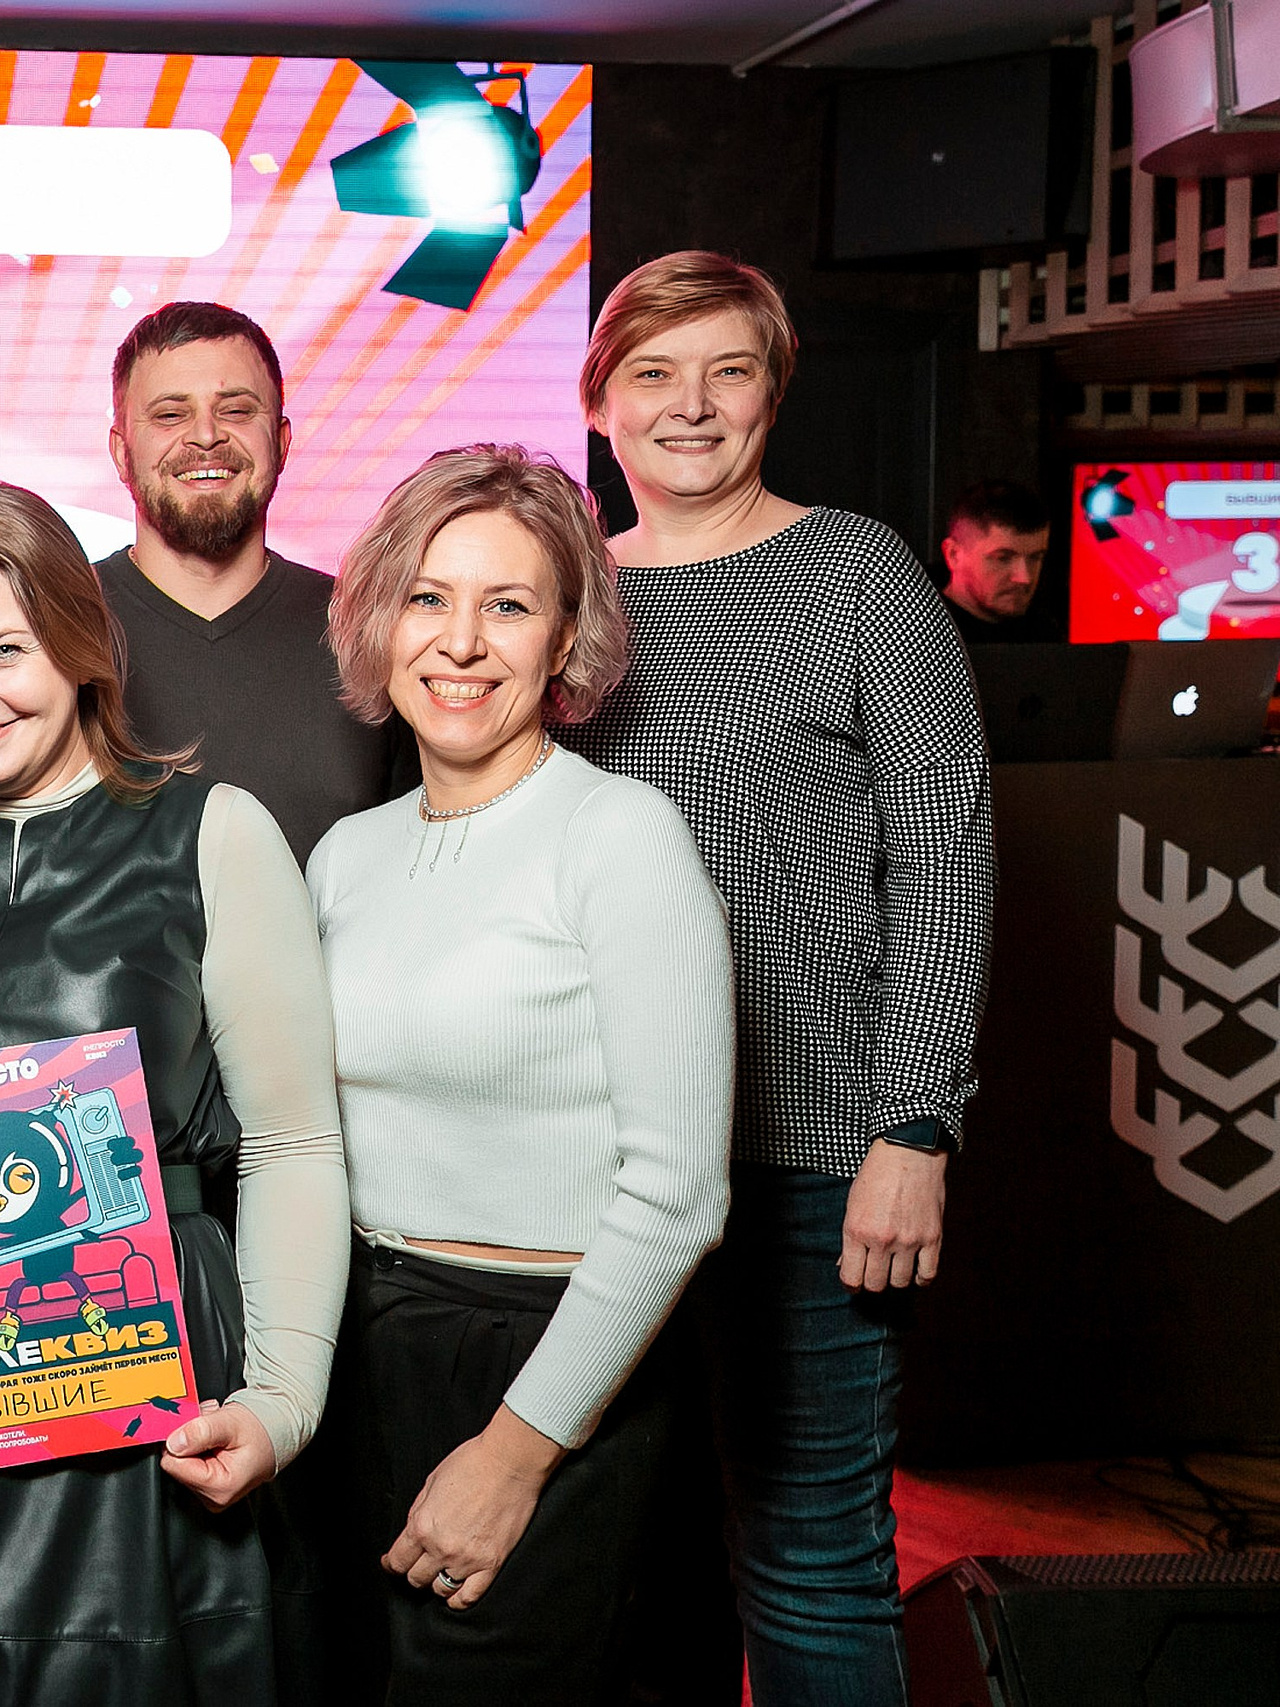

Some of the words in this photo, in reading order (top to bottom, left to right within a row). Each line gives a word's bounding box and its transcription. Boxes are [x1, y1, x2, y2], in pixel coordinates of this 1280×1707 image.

[1232, 531, 1279, 593] 3
[22, 1373, 47, 1385] ТОЖЕ
[48, 1368, 78, 1380] СКОРО
[114, 1357, 148, 1369] ПЕРВОЕ
[149, 1351, 178, 1363] МЕСТО
